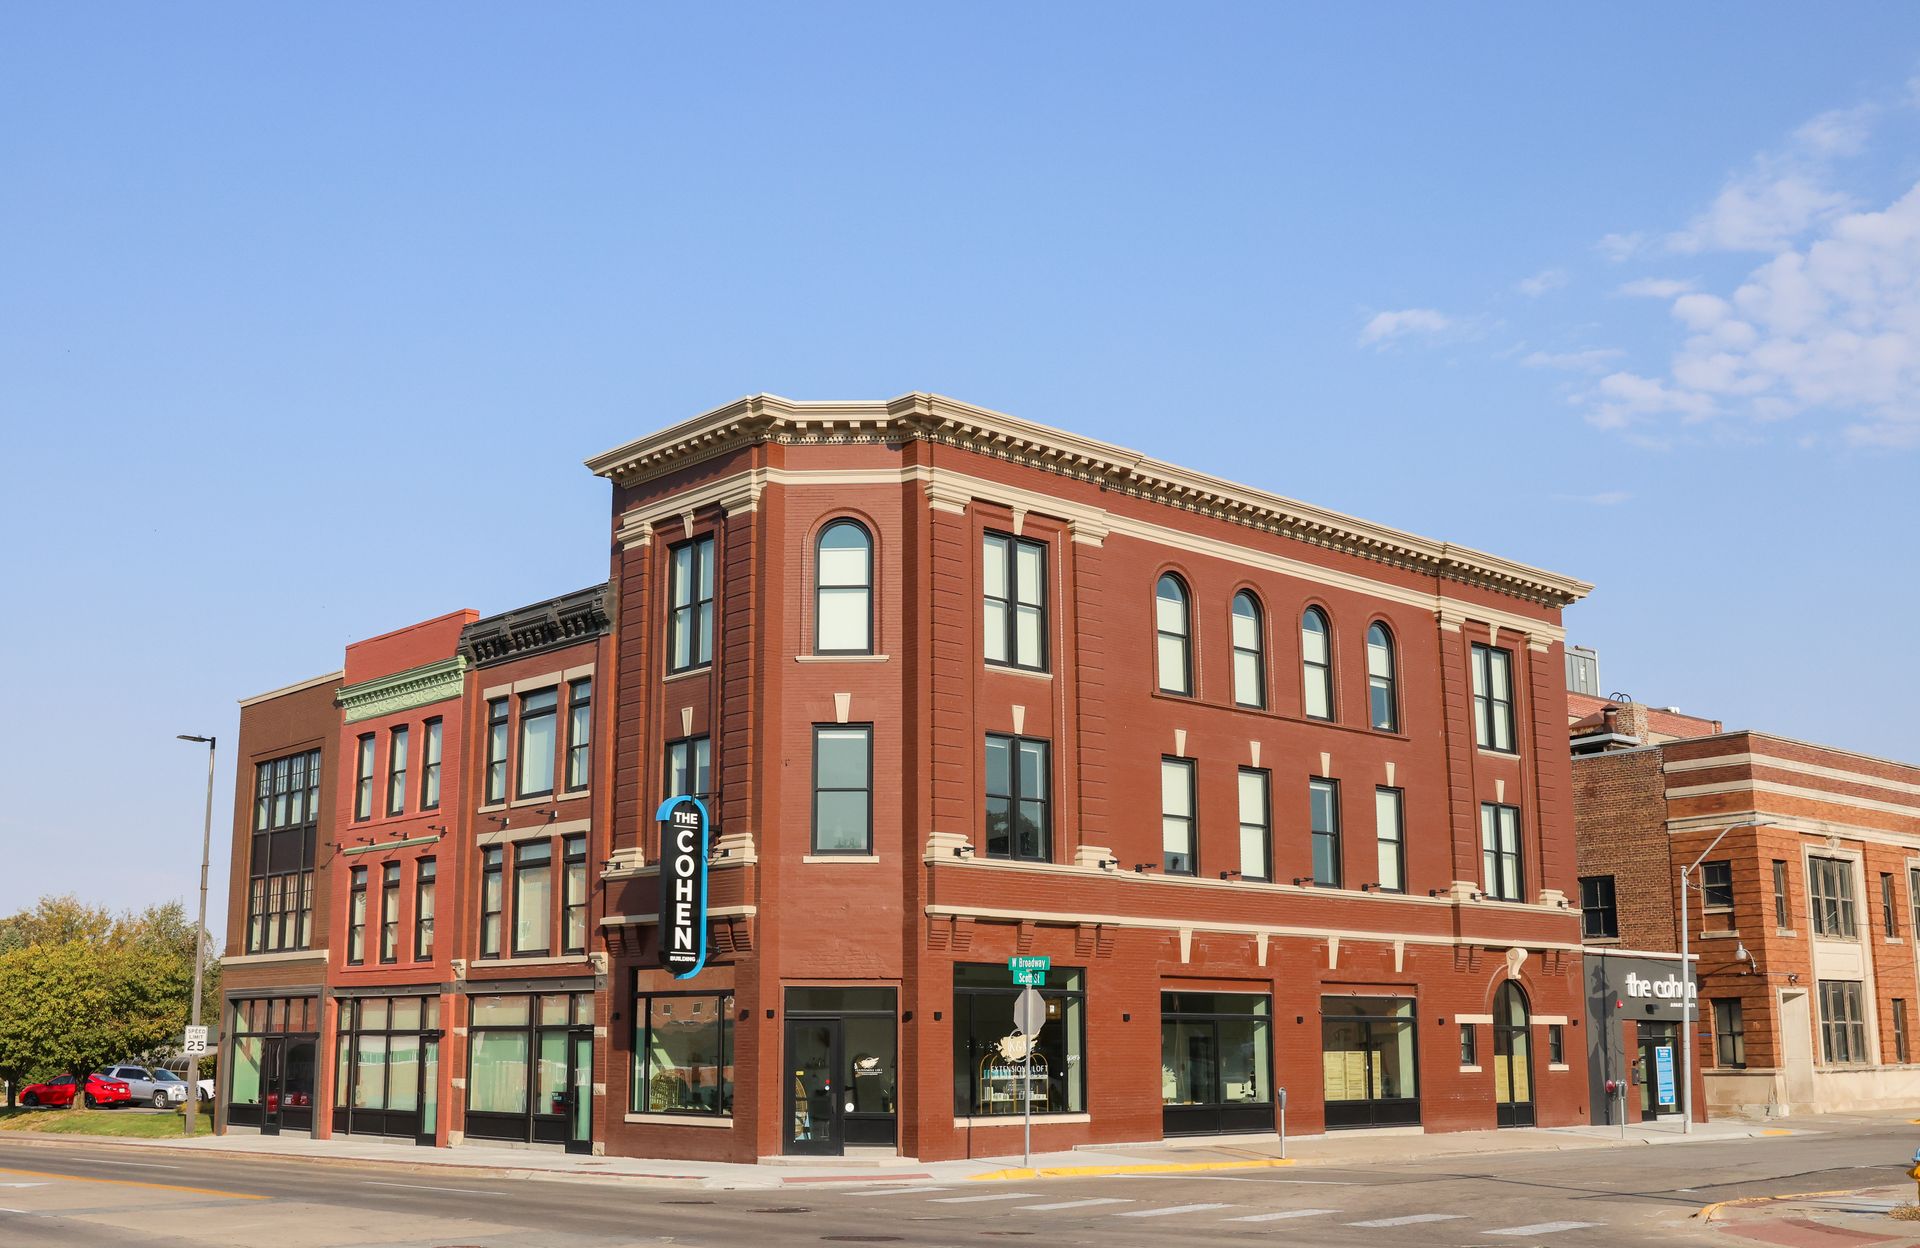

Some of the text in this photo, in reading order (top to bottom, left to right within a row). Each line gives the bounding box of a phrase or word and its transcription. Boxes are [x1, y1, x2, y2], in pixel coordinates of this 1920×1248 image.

[674, 811, 698, 825] THE
[674, 830, 695, 950] COHEN
[1012, 957, 1046, 970] W Broadway
[1018, 972, 1040, 984] Scott St
[1625, 972, 1651, 997] the
[187, 1040, 205, 1051] 25
[1032, 1065, 1049, 1073] LOFT
